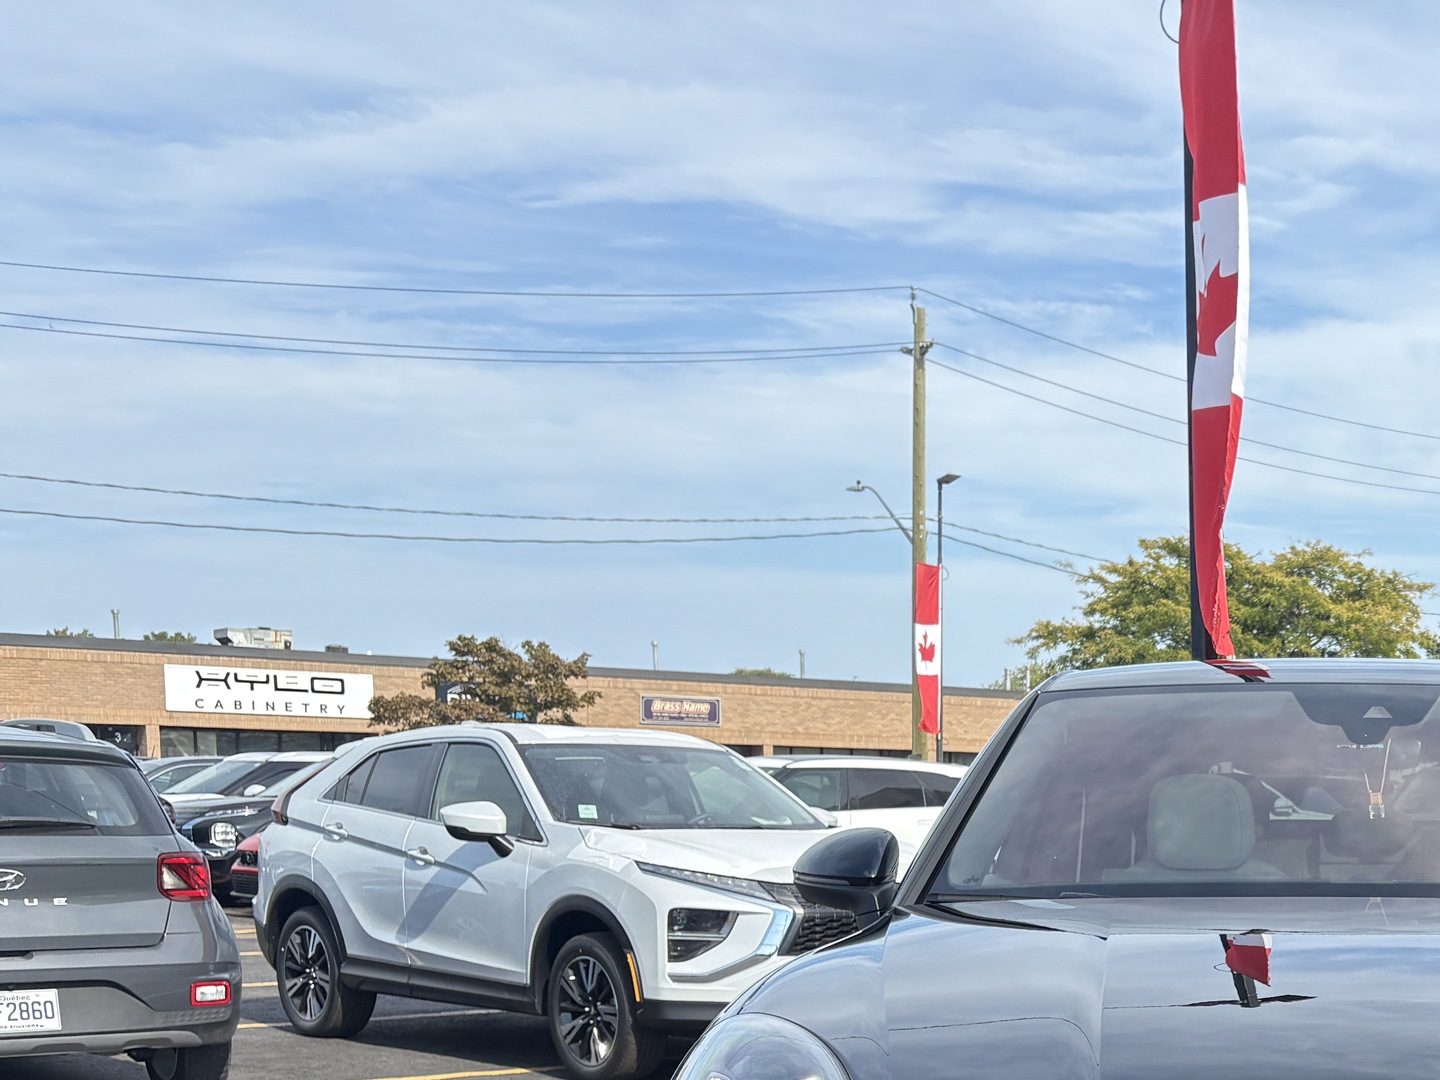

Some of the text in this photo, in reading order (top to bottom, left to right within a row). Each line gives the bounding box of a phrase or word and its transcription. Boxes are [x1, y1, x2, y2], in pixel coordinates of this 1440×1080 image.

[195, 670, 346, 696] XYLO
[194, 698, 346, 715] CABINETRY
[651, 700, 710, 714] Brass Name
